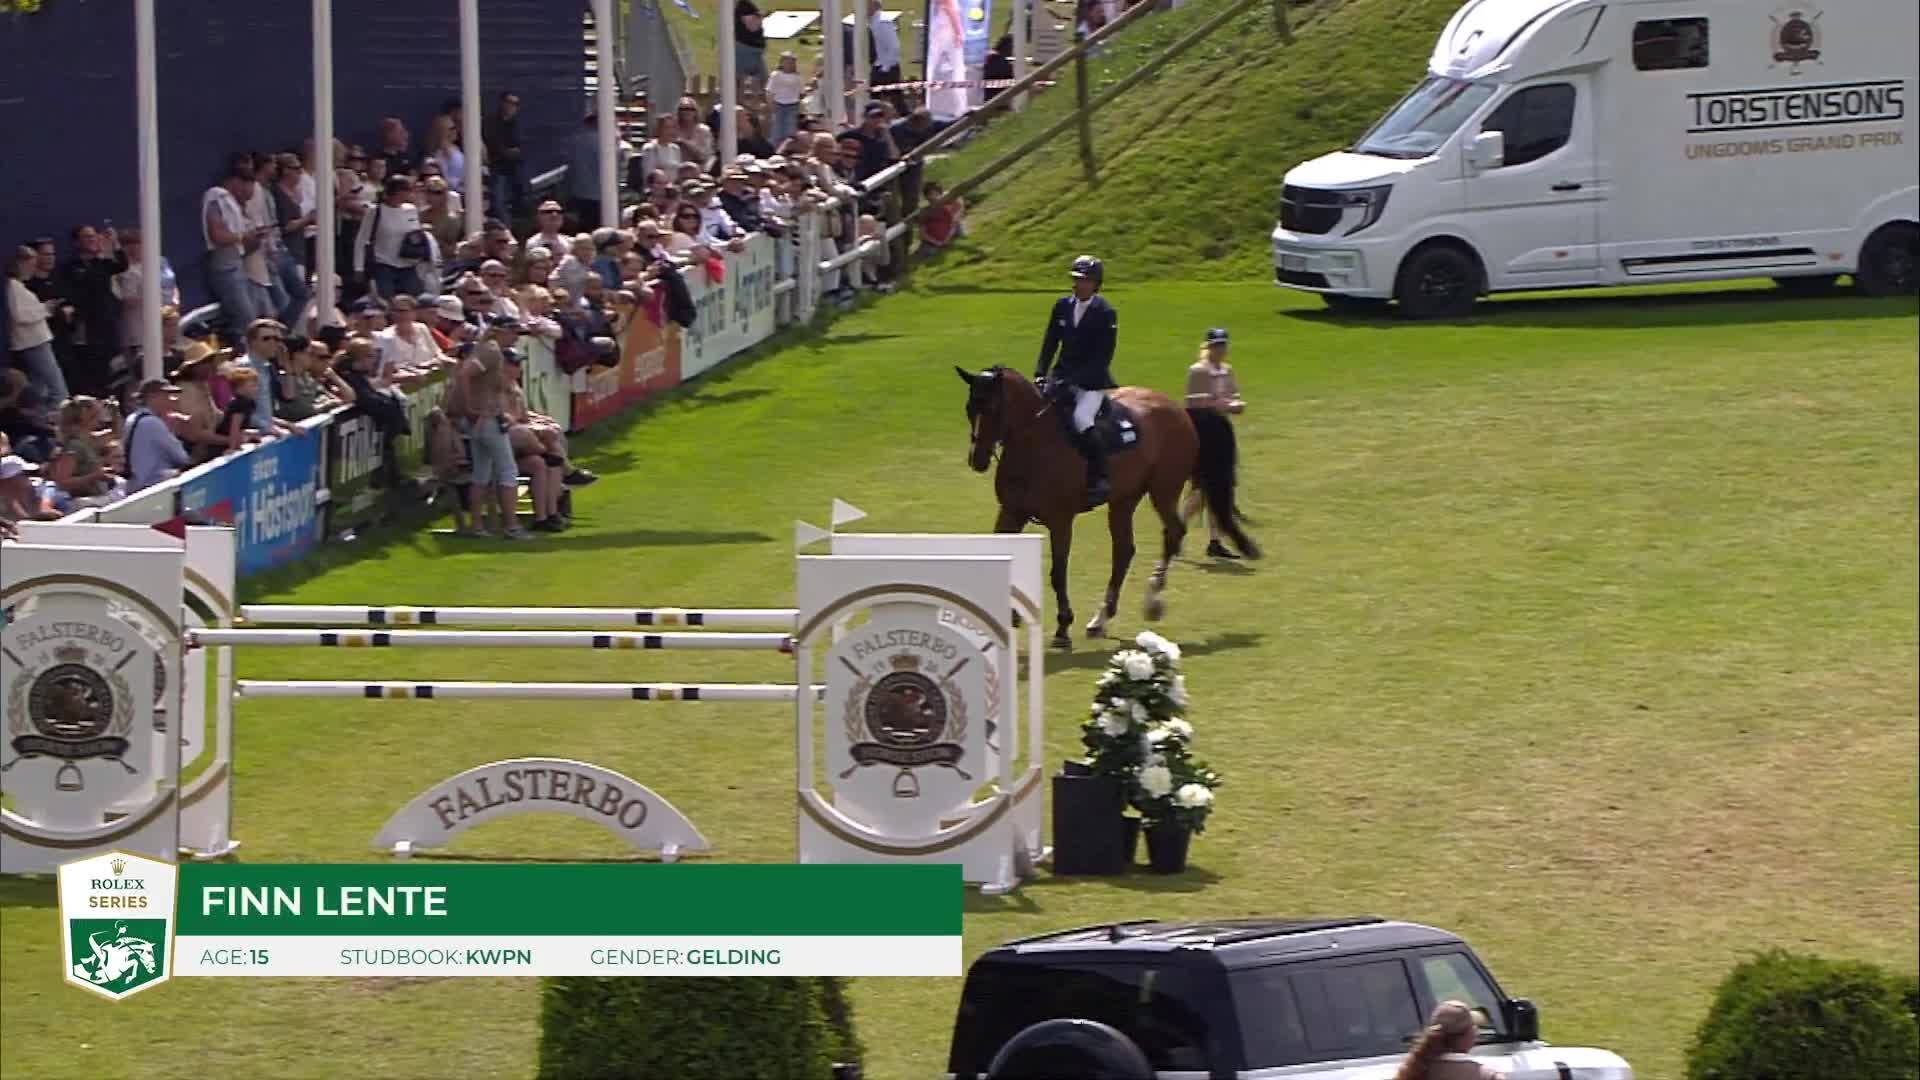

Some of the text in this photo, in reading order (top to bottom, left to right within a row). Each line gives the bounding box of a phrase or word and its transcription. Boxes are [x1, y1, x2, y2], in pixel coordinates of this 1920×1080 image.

[1686, 81, 1904, 133] TORSTENSONS
[1685, 131, 1904, 160] UNGDOMS GRAND PRIX
[15, 621, 125, 653] FALSTERBO
[853, 629, 957, 660] FALSTERBO
[428, 769, 649, 831] FALSTERBO
